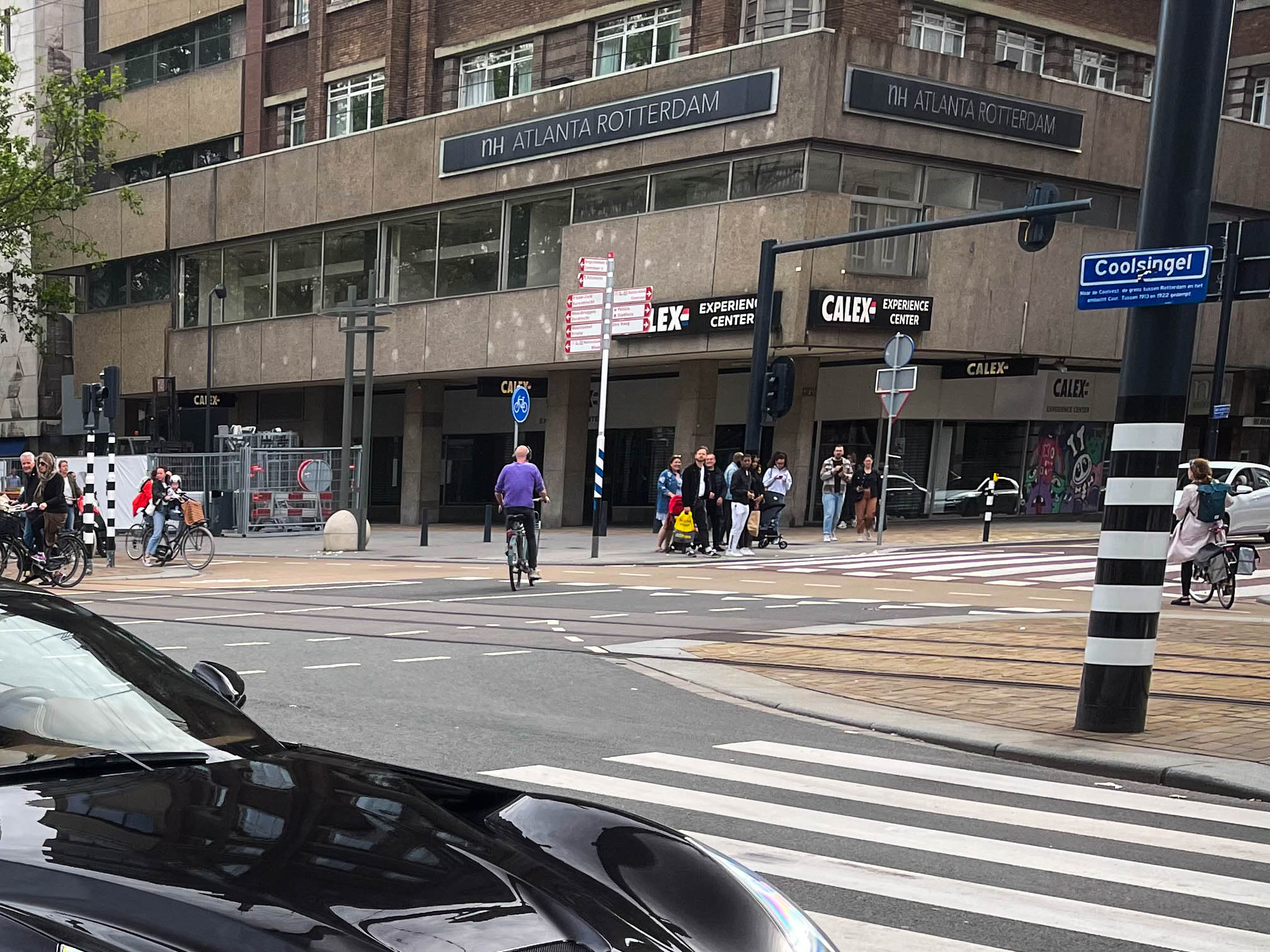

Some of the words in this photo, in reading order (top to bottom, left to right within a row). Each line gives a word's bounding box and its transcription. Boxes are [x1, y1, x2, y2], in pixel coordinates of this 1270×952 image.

[512, 117, 591, 151] ATLANTA
[597, 90, 720, 134] ROTTERDAM
[914, 89, 975, 120] ATLANTA
[978, 101, 1056, 136] ROTTERDAM
[1095, 253, 1192, 276] Coolsingel
[699, 298, 758, 314] EXPERIEN
[822, 294, 873, 323] CALEX
[883, 298, 929, 312] EXPERIENCE
[650, 305, 684, 332] LEX
[710, 313, 755, 328] CENTER
[890, 313, 920, 325] CENTER
[966, 362, 1005, 376] CALEX
[1053, 378, 1087, 398] CALEX
